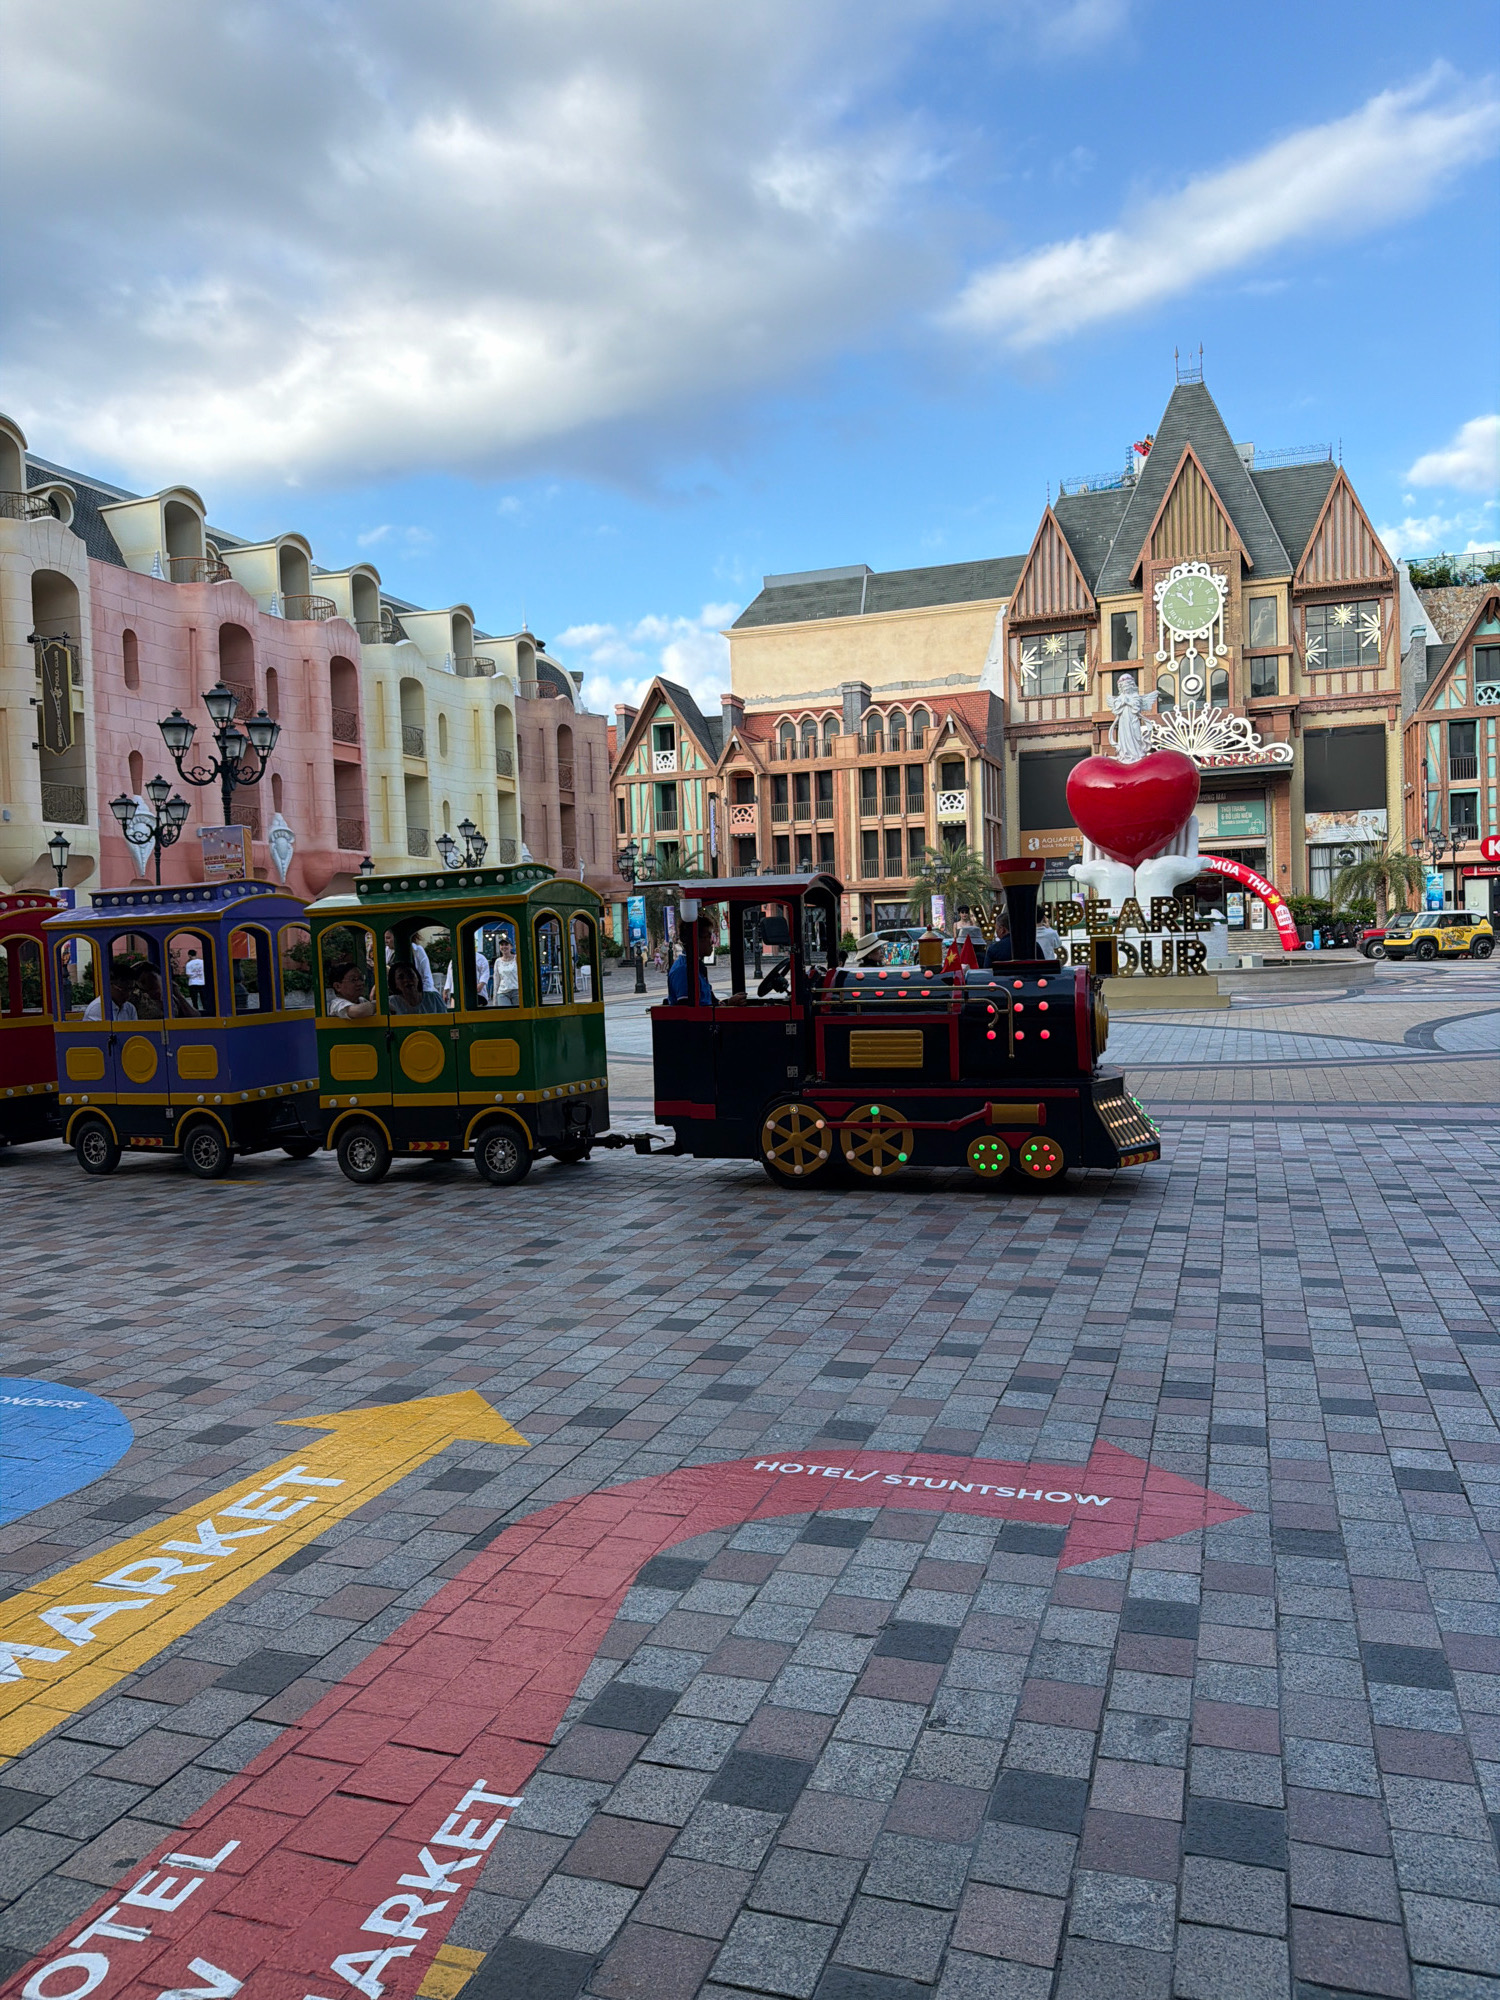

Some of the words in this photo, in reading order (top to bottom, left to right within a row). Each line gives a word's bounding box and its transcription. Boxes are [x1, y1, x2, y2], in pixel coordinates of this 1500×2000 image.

[1200, 750, 1276, 768] MARKET
[1210, 859, 1240, 877] MÙA
[1247, 873, 1272, 895] THU
[882, 1474, 1114, 1507] STUNTSHOW
[303, 1778, 525, 2000] ARKET
